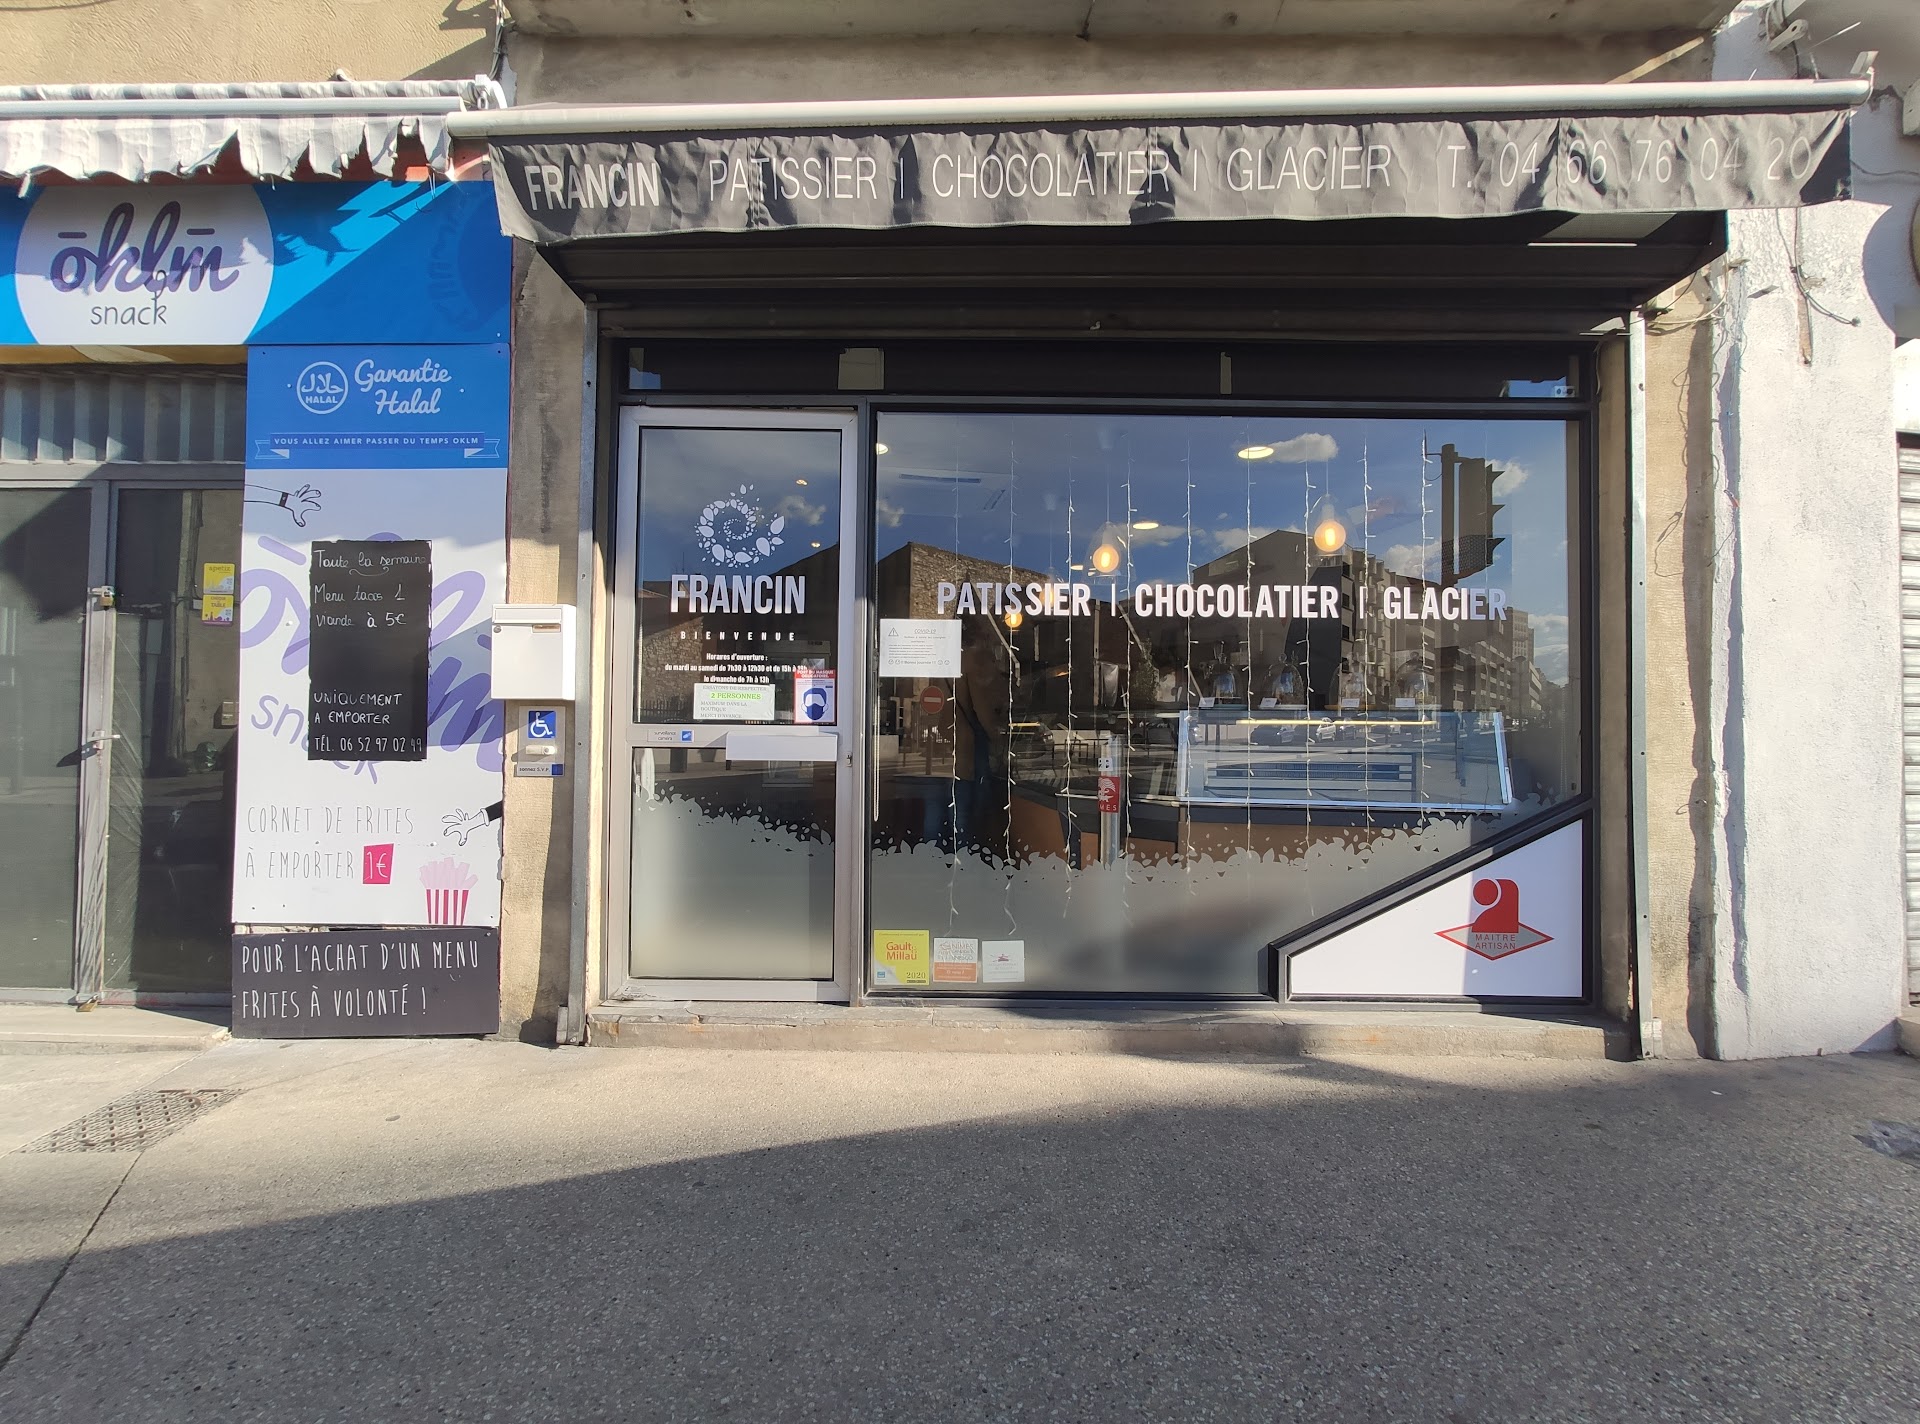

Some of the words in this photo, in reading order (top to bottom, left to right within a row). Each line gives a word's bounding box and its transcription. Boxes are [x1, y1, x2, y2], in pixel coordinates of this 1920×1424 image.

[524, 161, 660, 212] FRANCIN
[709, 156, 878, 203] PATISSIER
[931, 149, 1170, 200] CHOCOLATIER
[1225, 144, 1392, 192] GLACIER
[1447, 145, 1473, 188] T.
[1499, 144, 1541, 187] 04
[1565, 139, 1608, 185] 66
[1635, 139, 1672, 184] 76
[1698, 137, 1742, 182] 04
[1766, 135, 1812, 182] 20
[89, 292, 168, 327] snack
[354, 358, 453, 392] Garantie
[305, 395, 339, 404] HALAL
[375, 387, 442, 415] Halal
[273, 437, 299, 446] VOUS
[302, 437, 330, 446] ALLEZ
[333, 437, 363, 446] AIMER
[366, 437, 400, 446] PASSER
[403, 437, 416, 446] DU
[419, 437, 450, 446] TEMPS
[452, 437, 479, 446] OKLM
[313, 549, 349, 568] Toute
[358, 551, 374, 567] la
[314, 583, 346, 604] Menu
[353, 584, 383, 602] tacos
[394, 583, 406, 601] 1
[670, 574, 806, 614] FRANCIN
[937, 582, 1091, 617] PATISSIER
[1134, 583, 1340, 619] CHOCOLATIER
[1383, 586, 1507, 621] GLACIER
[367, 611, 378, 628] à
[385, 611, 407, 627] 5€
[706, 652, 730, 661] Horaires
[664, 663, 672, 671] du
[673, 663, 689, 671] mardi
[698, 664, 718, 672] samedi
[719, 664, 726, 672] de
[727, 664, 742, 672] 7h30
[748, 664, 765, 672] 12h30
[773, 664, 780, 672] de
[710, 675, 737, 683] dimanche
[738, 675, 745, 683] de
[746, 675, 753, 683] 7h
[759, 675, 770, 683] 13h
[717, 692, 762, 700] PERSONNES
[314, 712, 321, 724] A
[328, 710, 391, 724] EMPORTER
[314, 734, 335, 752] TÉL.
[340, 737, 353, 752] 06
[357, 736, 371, 752] 52
[375, 737, 388, 752] 97
[392, 736, 406, 752] 02
[410, 737, 423, 752] 49
[247, 804, 313, 833] CORNET
[325, 806, 343, 834] DE
[356, 805, 415, 835] FRITES
[245, 846, 255, 878] À
[268, 850, 355, 879] EMPORTER
[365, 851, 390, 881] 1€
[886, 941, 911, 951] Gault
[1475, 934, 1516, 942] MAITRE
[242, 944, 285, 974] POUR
[293, 943, 369, 973] L'ACHAT
[380, 941, 421, 970] D'UN
[432, 940, 480, 969] MENU
[886, 951, 917, 961] Millau
[906, 971, 926, 979] 2020
[242, 989, 300, 1019] FRITES
[310, 985, 322, 1018] À
[334, 984, 410, 1017] VOLONTÉ
[421, 986, 427, 1015] !
